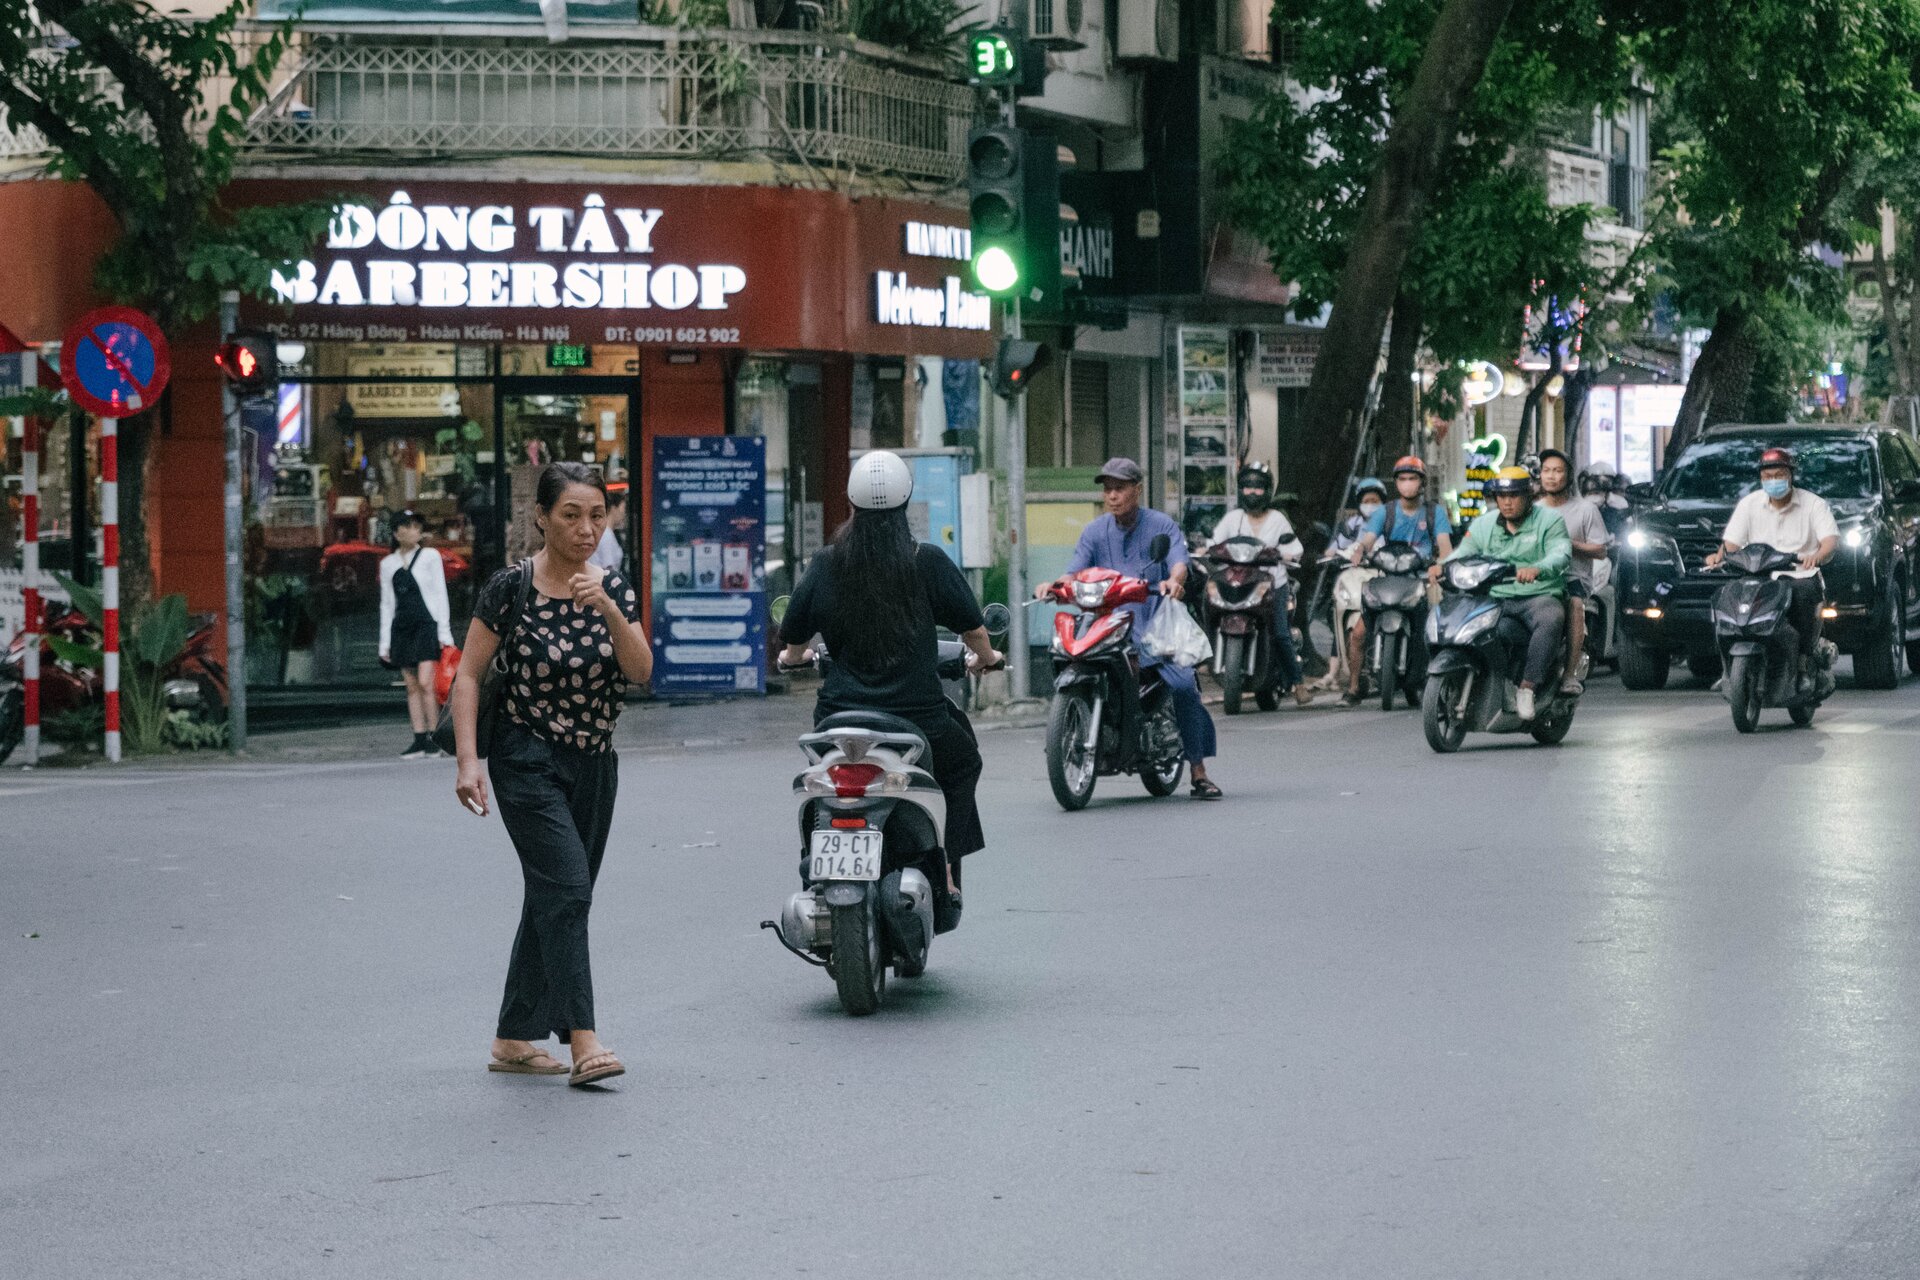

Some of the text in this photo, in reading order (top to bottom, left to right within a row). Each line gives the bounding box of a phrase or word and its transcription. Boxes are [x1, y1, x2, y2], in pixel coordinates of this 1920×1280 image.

[326, 190, 663, 253] ĐÔNG TÂY
[270, 260, 747, 310] BARBERSHOP
[299, 323, 320, 338] 92
[322, 322, 364, 341] Hàng
[420, 323, 460, 340] Hoàn
[463, 322, 504, 340] Kiếm
[516, 325, 540, 341] Hà
[542, 324, 570, 345] Nội
[604, 326, 740, 344] ĐT: 0901 602 902
[821, 835, 870, 855] 29-C1
[814, 856, 874, 877] 014.64
